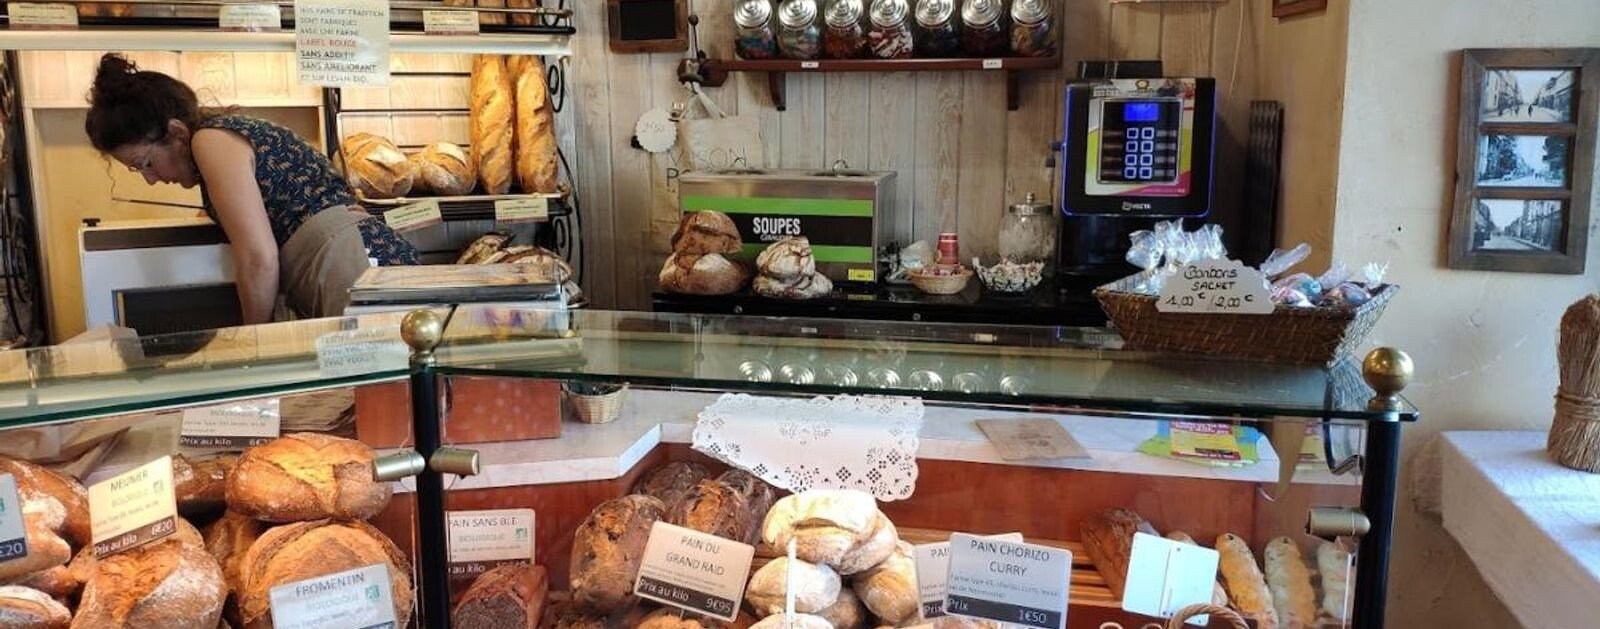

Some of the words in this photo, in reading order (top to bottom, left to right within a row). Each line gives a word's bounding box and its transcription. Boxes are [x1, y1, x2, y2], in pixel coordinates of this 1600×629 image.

[299, 50, 322, 60] SANS
[300, 61, 323, 71] SANS
[752, 216, 802, 235] SOUPES
[1183, 265, 1238, 280] Bonbons
[1190, 281, 1237, 292] SACHET
[214, 437, 233, 446] kilo
[471, 517, 498, 528] SANS
[122, 533, 138, 547] kilo
[680, 536, 703, 551] PAIN
[705, 542, 721, 555] DU
[970, 539, 997, 554] PAIN
[999, 542, 1050, 562] CHORIZO
[466, 562, 487, 573] kilo
[665, 552, 700, 570] GRAND
[701, 561, 726, 577] RAID
[988, 560, 1028, 577] CURRY
[295, 570, 365, 598] FROMENTIN
[638, 578, 656, 592] Prix
[657, 586, 671, 597] au
[671, 586, 690, 602] kilo
[705, 597, 732, 613] 9€95
[948, 597, 969, 612] Prix
[1018, 609, 1049, 625] 1€50
